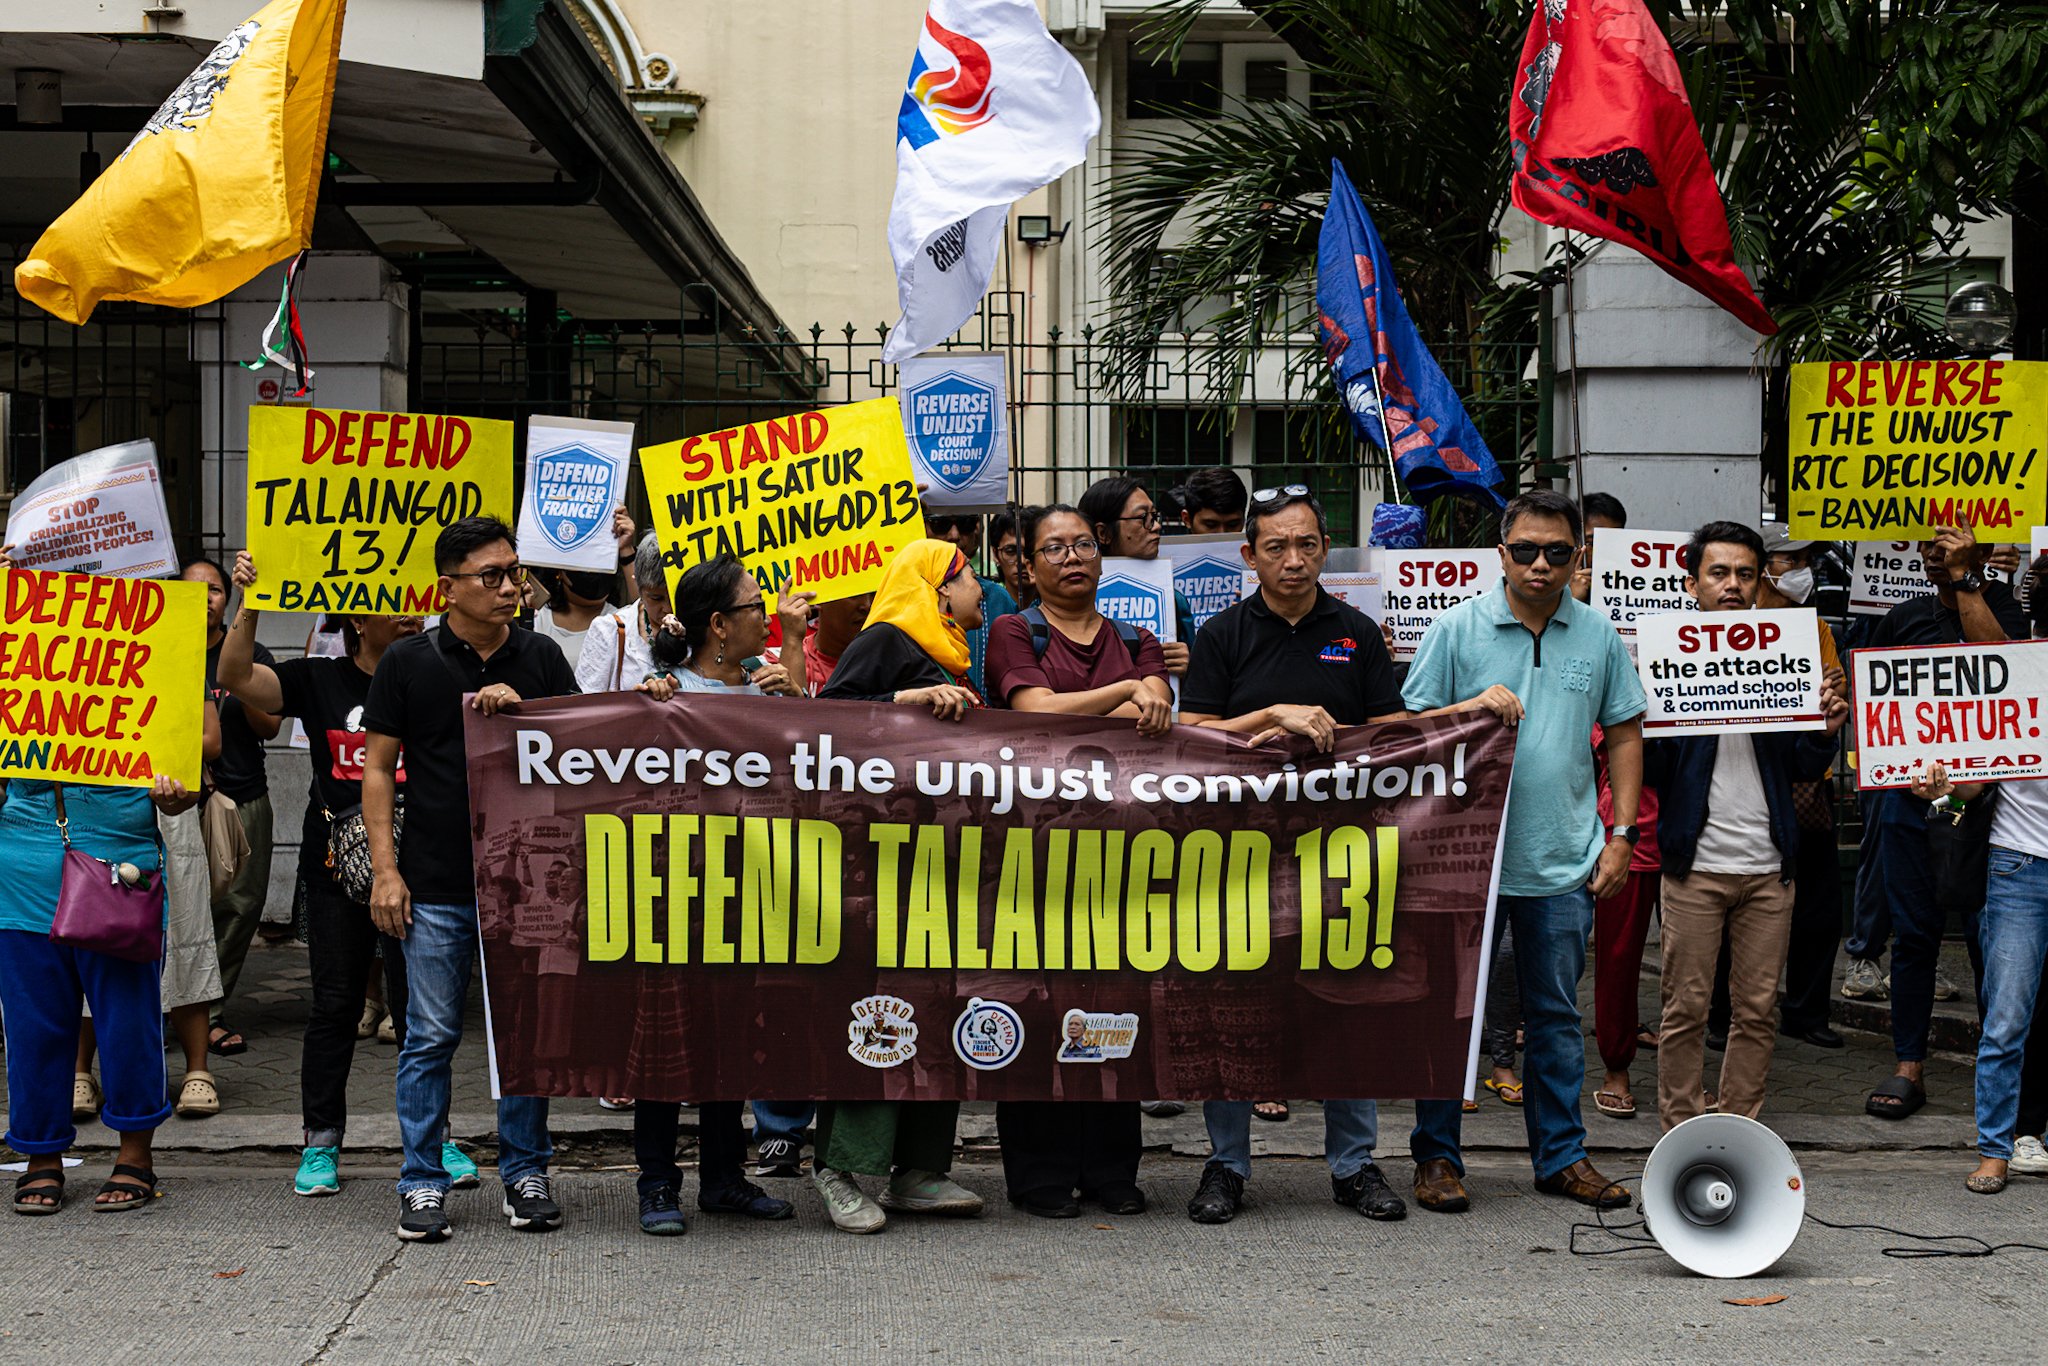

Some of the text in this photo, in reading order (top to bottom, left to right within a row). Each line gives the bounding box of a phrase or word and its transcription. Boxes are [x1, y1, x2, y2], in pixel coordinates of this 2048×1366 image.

[1826, 359, 2005, 408] REVERSE
[916, 393, 990, 415] REVERSE
[921, 414, 986, 436] UNJUST
[1805, 410, 2013, 447] THE UNJUST
[302, 409, 472, 471] DEFEND
[681, 411, 829, 481] STAND
[938, 435, 973, 448] COURT
[930, 447, 983, 462] DECISION!
[540, 461, 610, 484] DEFEND
[1791, 448, 2038, 491] RTC DECISION!
[539, 483, 607, 504] TEACHER
[666, 447, 864, 529] WITH SATUR
[47, 497, 100, 523] STOP
[255, 477, 482, 527] TALAINGOD
[540, 501, 601, 520] FRANCE!
[24, 521, 137, 555] SOLIDARITY WITH
[29, 511, 127, 542] CRIMINALIZING
[94, 530, 155, 553] PEOPLES!
[321, 527, 417, 578] 13!
[1863, 552, 1903, 571] the
[1399, 560, 1478, 588] STOP
[1602, 570, 1646, 591] the
[1863, 574, 1880, 583] vs
[4, 568, 166, 636] DEFEND
[1603, 596, 1622, 607] vs
[1625, 595, 1682, 610] Lumad
[1868, 585, 1879, 597] &
[1397, 614, 1432, 627] Luma
[1610, 608, 1622, 622] &
[1678, 622, 1781, 654] STOP
[0, 631, 152, 689] EACHER
[1317, 645, 1356, 657] ACT
[1649, 653, 1811, 680] the attacks
[1868, 654, 2009, 697] DEFEND
[1654, 678, 1811, 698] vs Lumad schools
[0, 687, 158, 741] RANCE!
[1663, 693, 1804, 713] & communities!
[1865, 697, 2041, 748] KA SATUR!
[516, 729, 772, 788] Reverse
[790, 734, 895, 793] the
[916, 747, 1113, 815] unjust
[1129, 742, 1469, 804] conviction!
[1991, 768, 2043, 776] DEMOCRACY
[1409, 824, 1464, 842] ASSERT
[1427, 844, 1449, 857] TO
[585, 813, 843, 965] DEFEND
[869, 822, 1272, 973] TALAINGOD
[1294, 825, 1399, 972] 13!
[856, 1000, 910, 1019] DEFEND
[991, 1011, 1013, 1045] DEFEND
[1082, 1029, 1134, 1047] SATUR!
[853, 1043, 913, 1064] TALAINGOD 13
